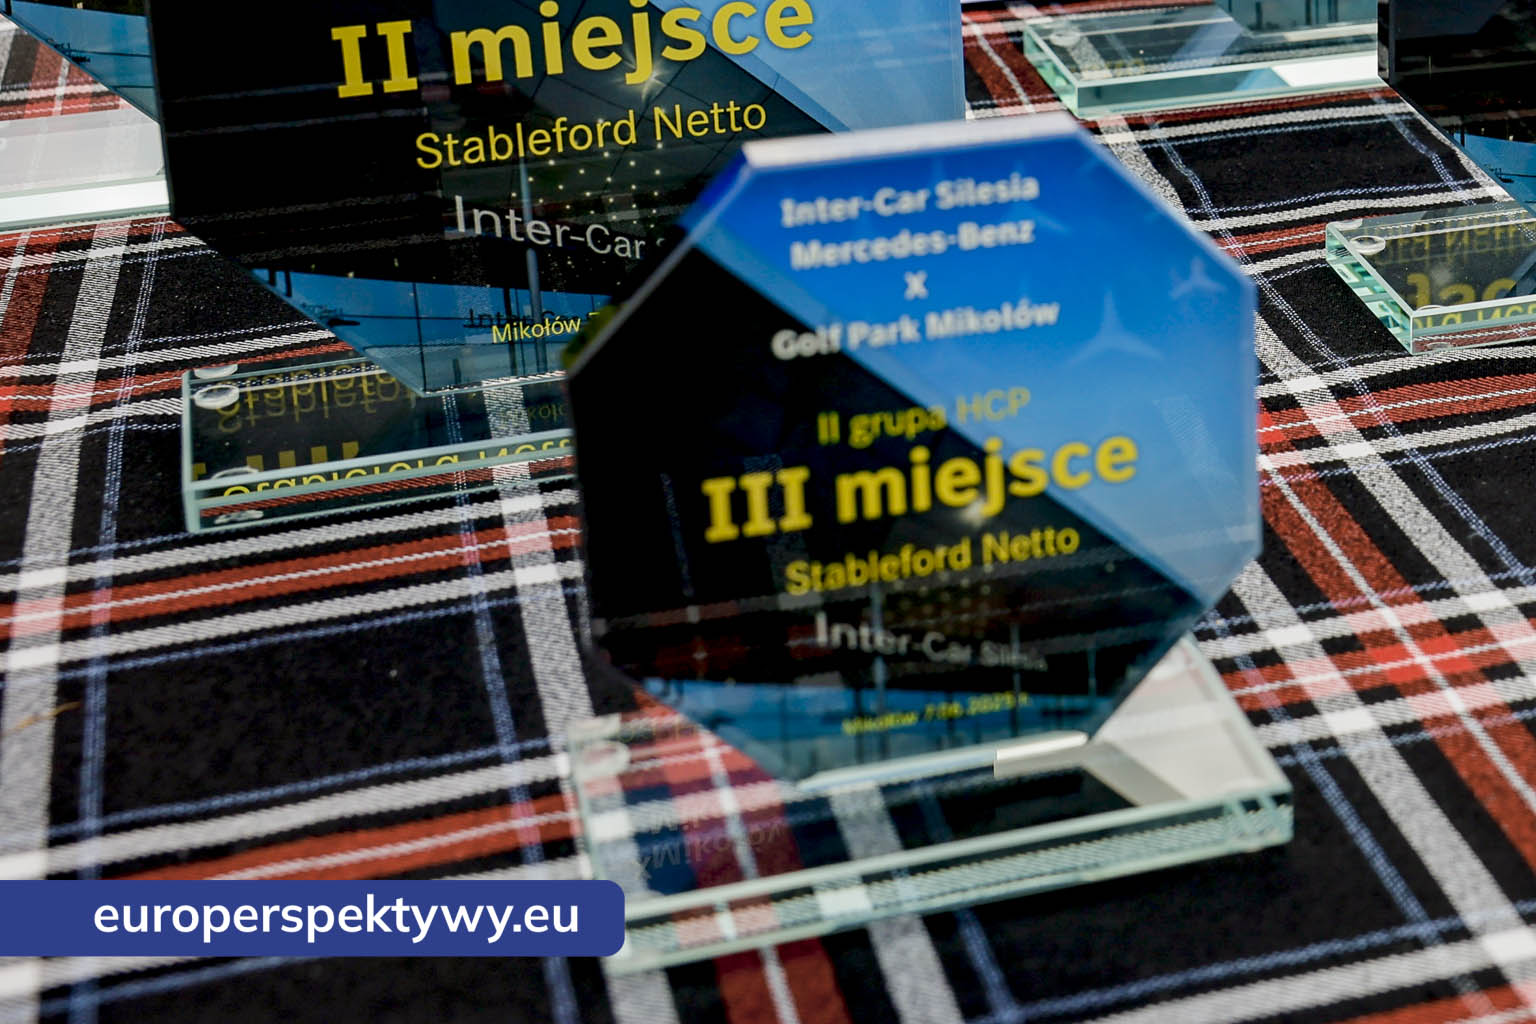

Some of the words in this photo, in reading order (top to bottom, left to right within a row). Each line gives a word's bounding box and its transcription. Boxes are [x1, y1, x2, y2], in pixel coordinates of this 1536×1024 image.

[331, 19, 418, 98] II
[415, 109, 637, 169] Stableford
[653, 99, 767, 141] Netto
[455, 195, 646, 259] Inter-Car
[780, 186, 930, 228] Inter-Car
[935, 172, 1040, 210] Silesia
[790, 220, 1035, 271] Mercedes-Benz
[492, 315, 581, 344] Mikołów
[771, 322, 842, 361] Golf
[846, 314, 921, 350] Park
[925, 296, 1060, 340] Mikołów
[817, 411, 840, 446] II
[849, 405, 946, 449] grupa
[956, 387, 1031, 422] HCP
[702, 465, 813, 544] III
[835, 436, 1139, 525] miejsce
[785, 537, 972, 597] Stableford
[982, 527, 1080, 565] Netto
